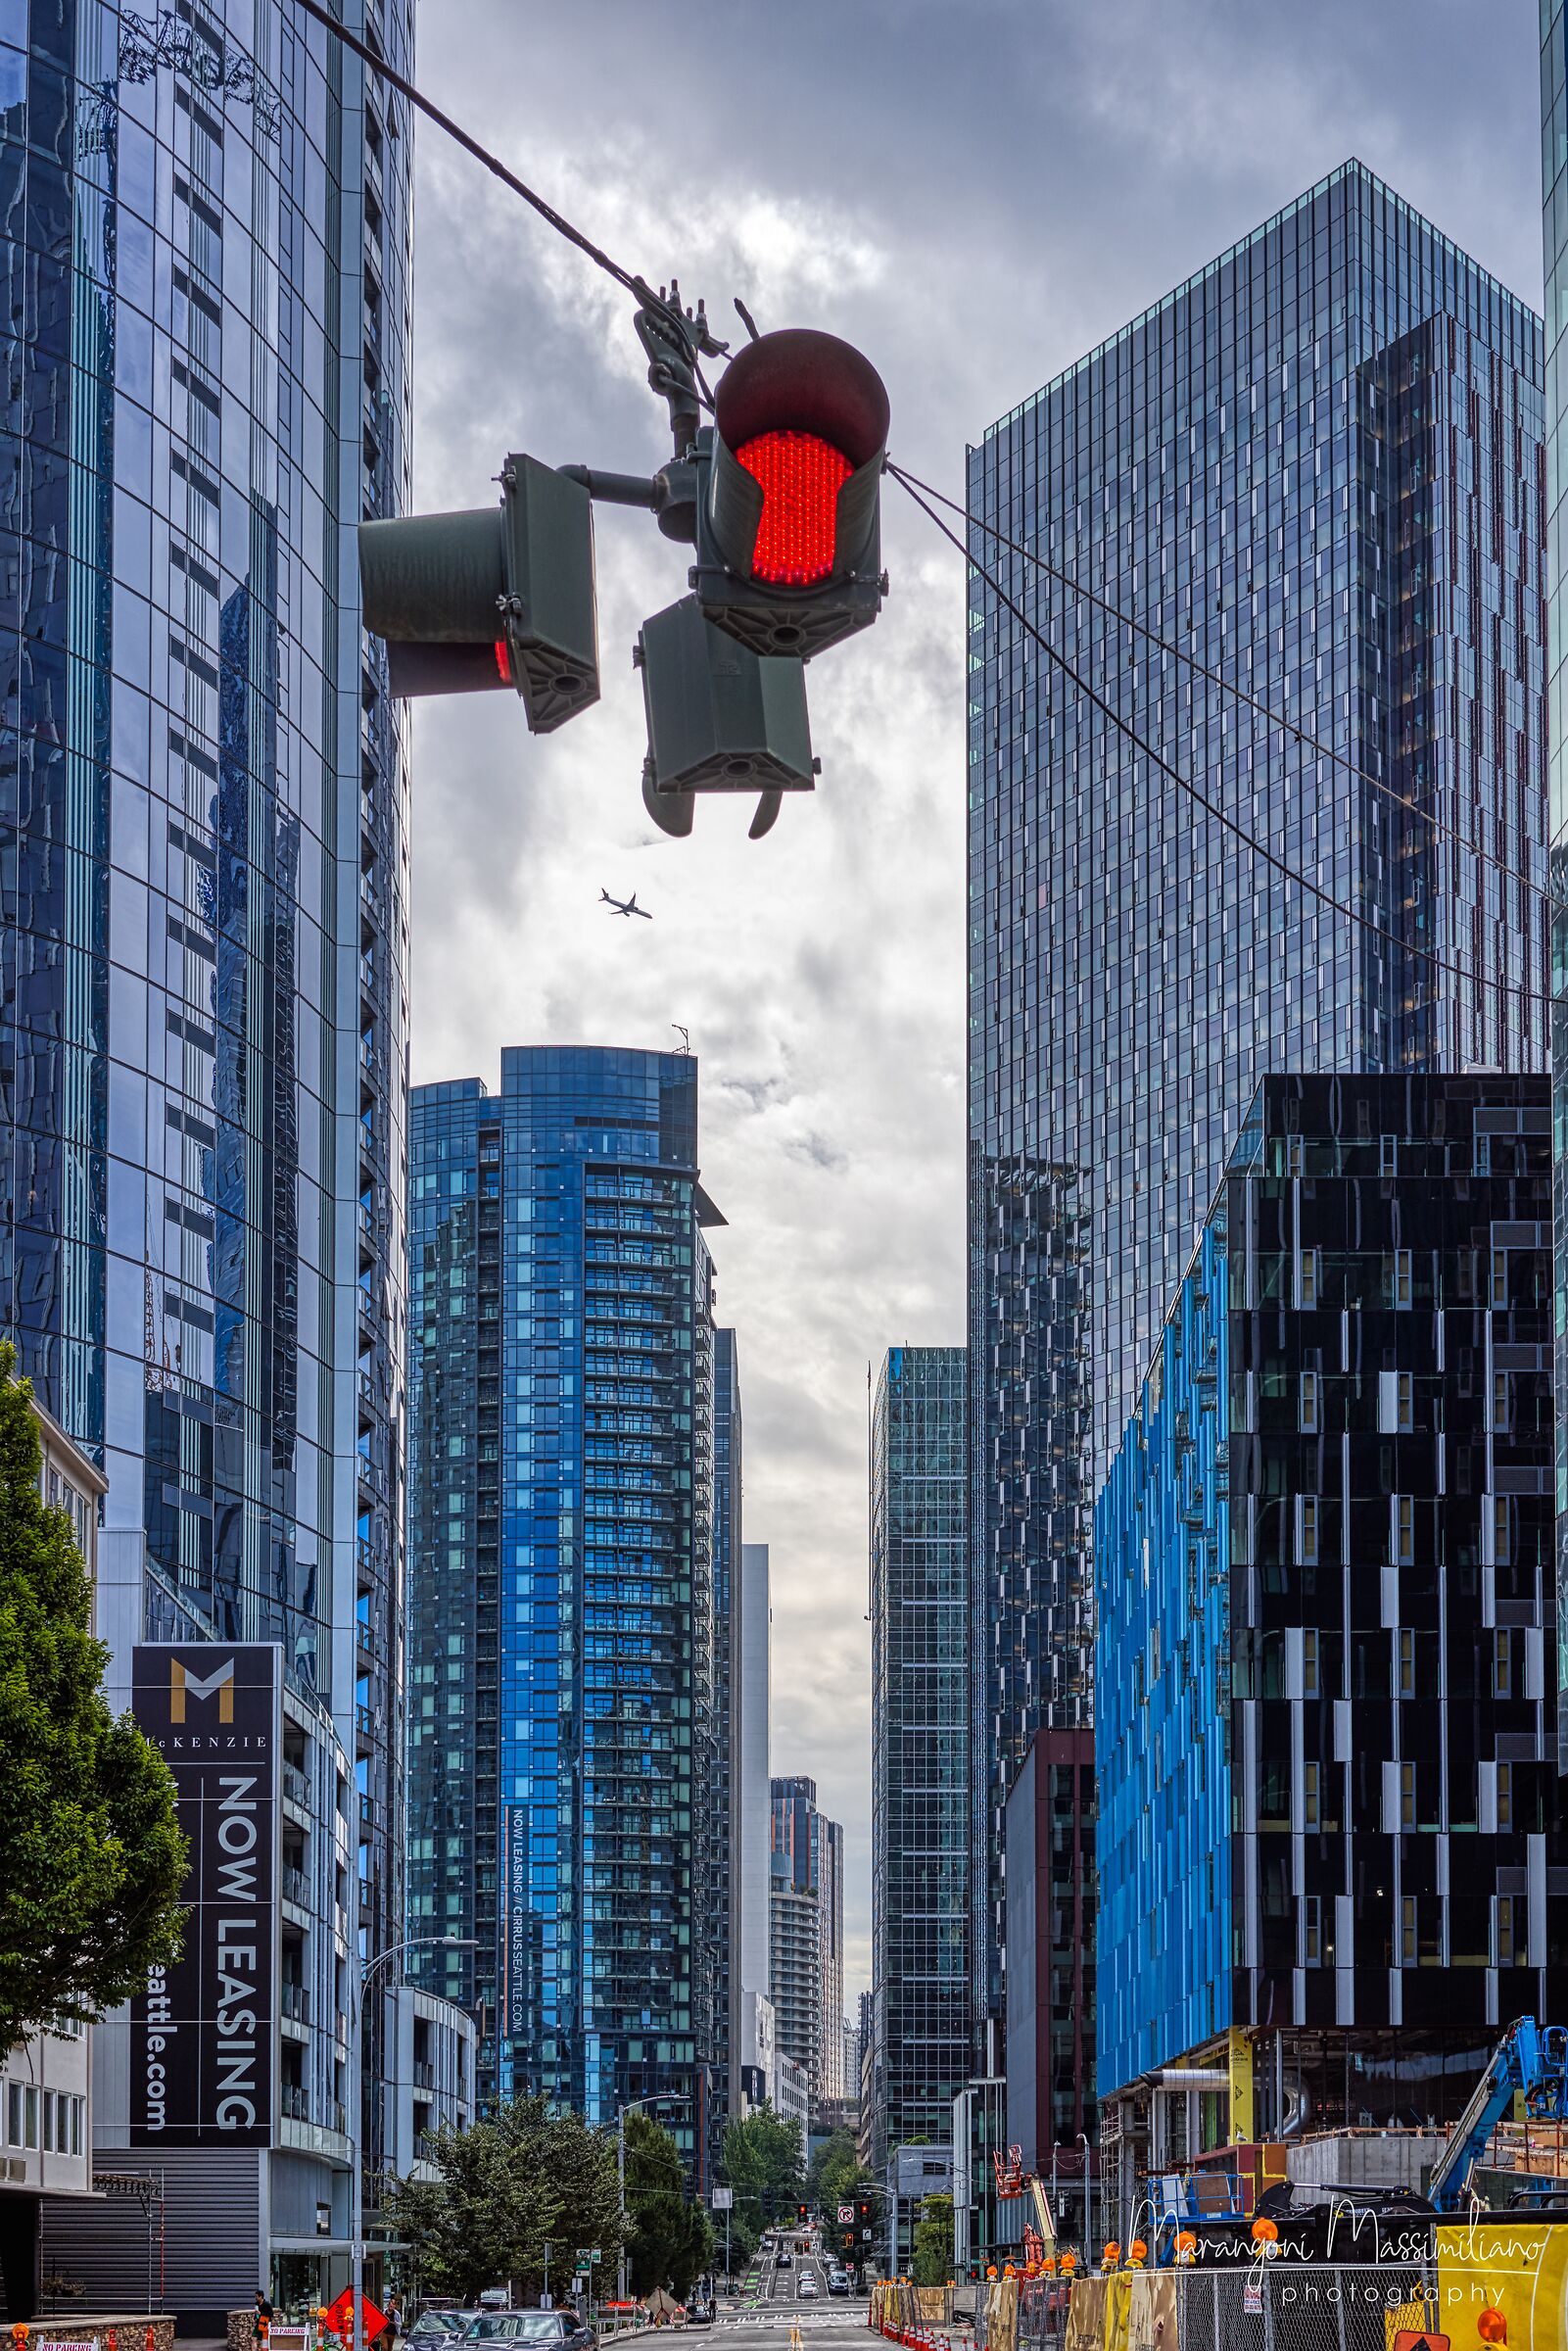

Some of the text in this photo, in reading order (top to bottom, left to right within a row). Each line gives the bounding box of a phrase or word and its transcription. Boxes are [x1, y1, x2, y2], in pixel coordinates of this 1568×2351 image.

[513, 1809, 523, 1840] NOW
[513, 1843, 523, 1894] LEASING
[216, 1777, 258, 2131] NOW LEASING
[512, 1905, 523, 2032] CIRRUSSEATTLE.COM
[147, 1964, 178, 2131] eattle.com
[335, 2304, 345, 2325] ROAD
